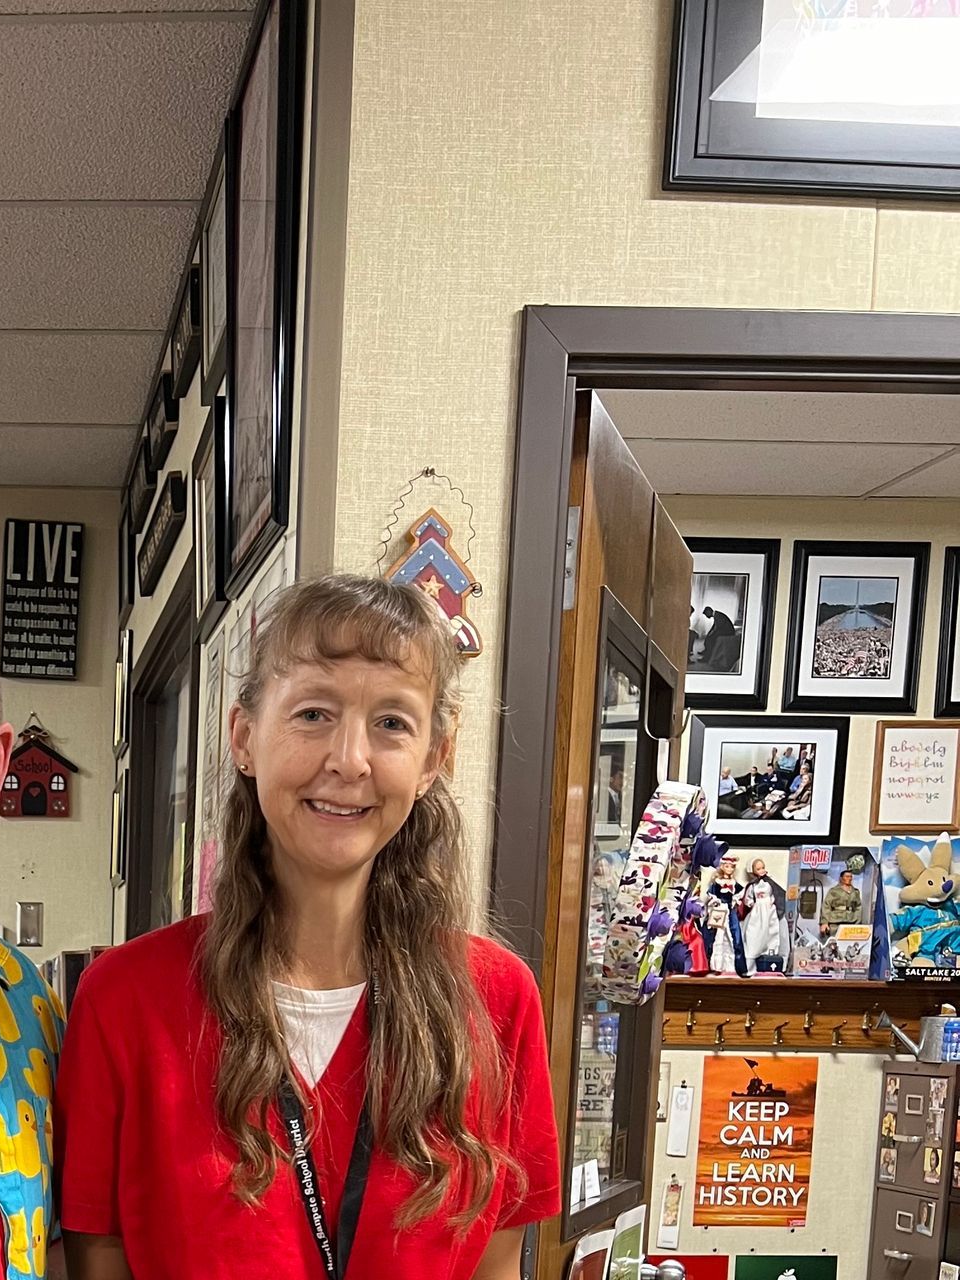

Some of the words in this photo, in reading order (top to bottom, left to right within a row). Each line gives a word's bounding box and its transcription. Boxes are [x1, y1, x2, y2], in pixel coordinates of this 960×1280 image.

[6, 522, 82, 584] LIVE
[14, 759, 54, 774] School
[905, 968, 927, 976] SALT
[927, 969, 950, 977] LAKE
[727, 1101, 790, 1122] KEEP
[719, 1125, 793, 1146] CALM
[740, 1148, 770, 1160] AND
[296, 1158, 315, 1196] School
[712, 1162, 795, 1184] LEARN
[698, 1186, 806, 1207] HISTORY
